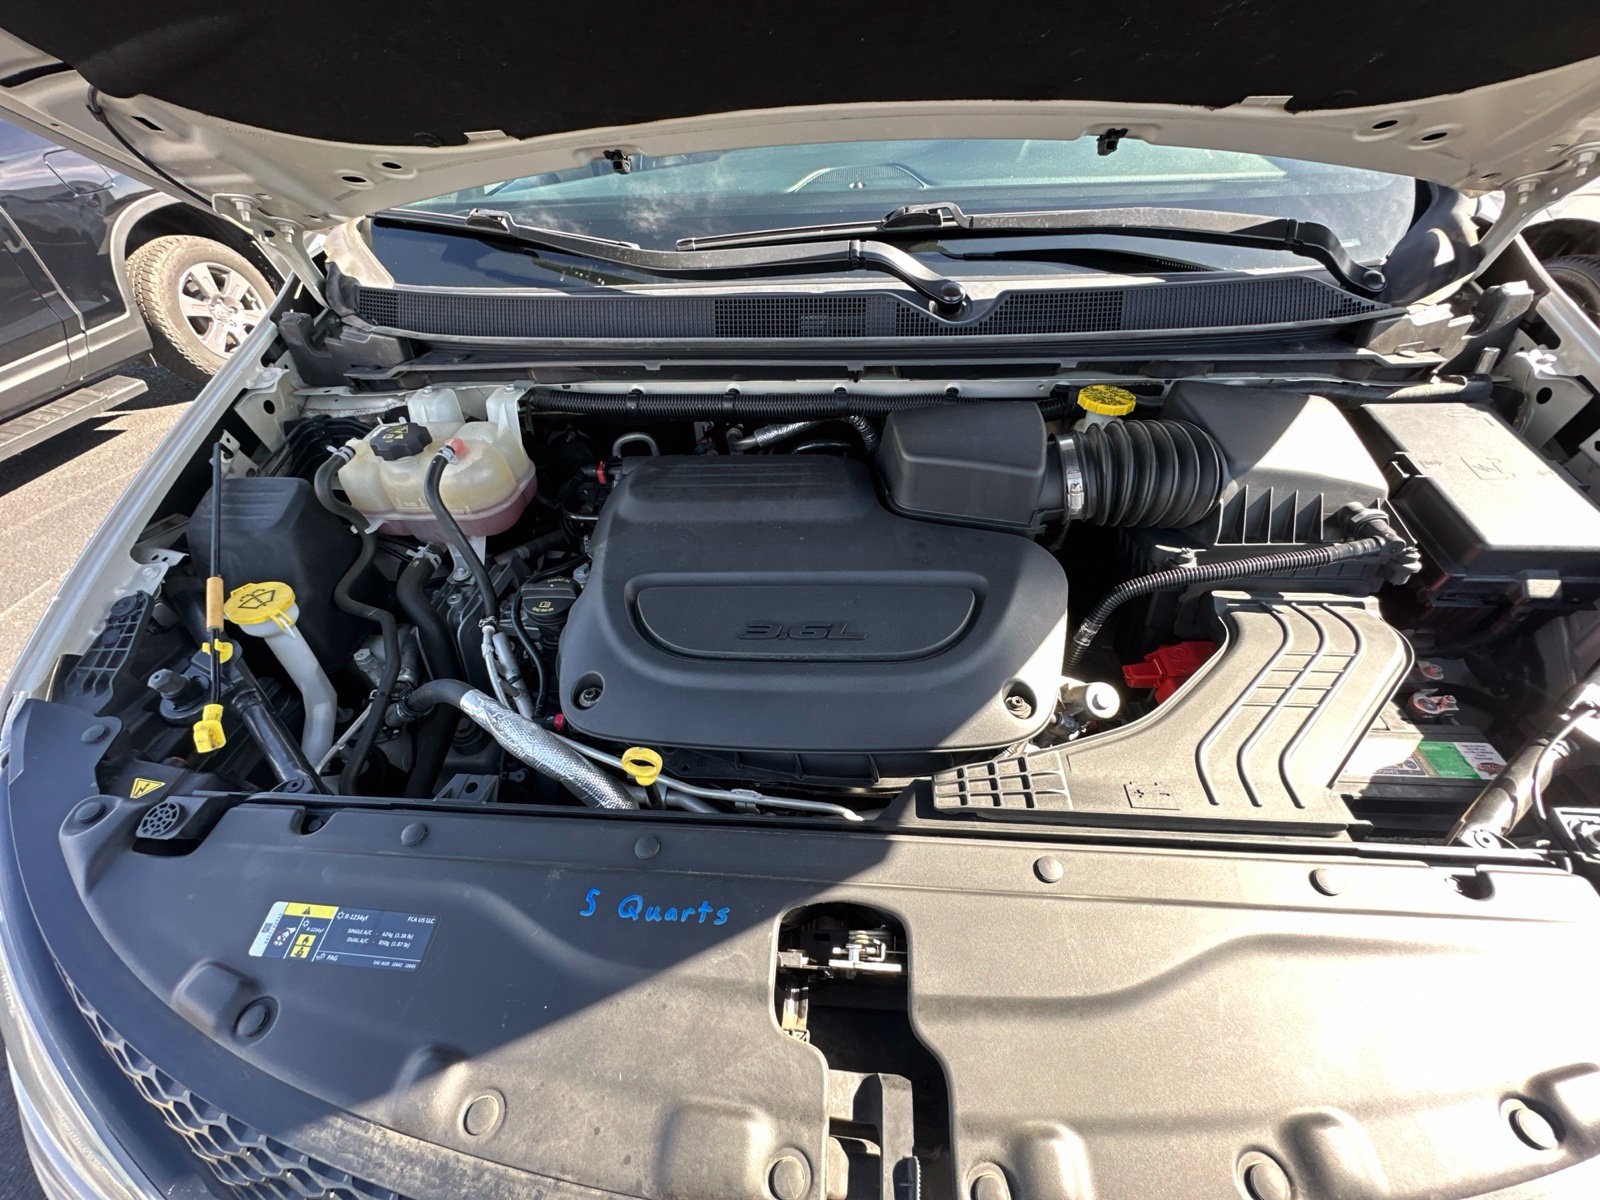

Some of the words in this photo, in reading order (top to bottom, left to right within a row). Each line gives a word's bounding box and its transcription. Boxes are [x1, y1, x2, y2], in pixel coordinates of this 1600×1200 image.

[737, 623, 868, 640] 3.6L
[579, 888, 601, 917] 5
[617, 894, 730, 926] Quarts
